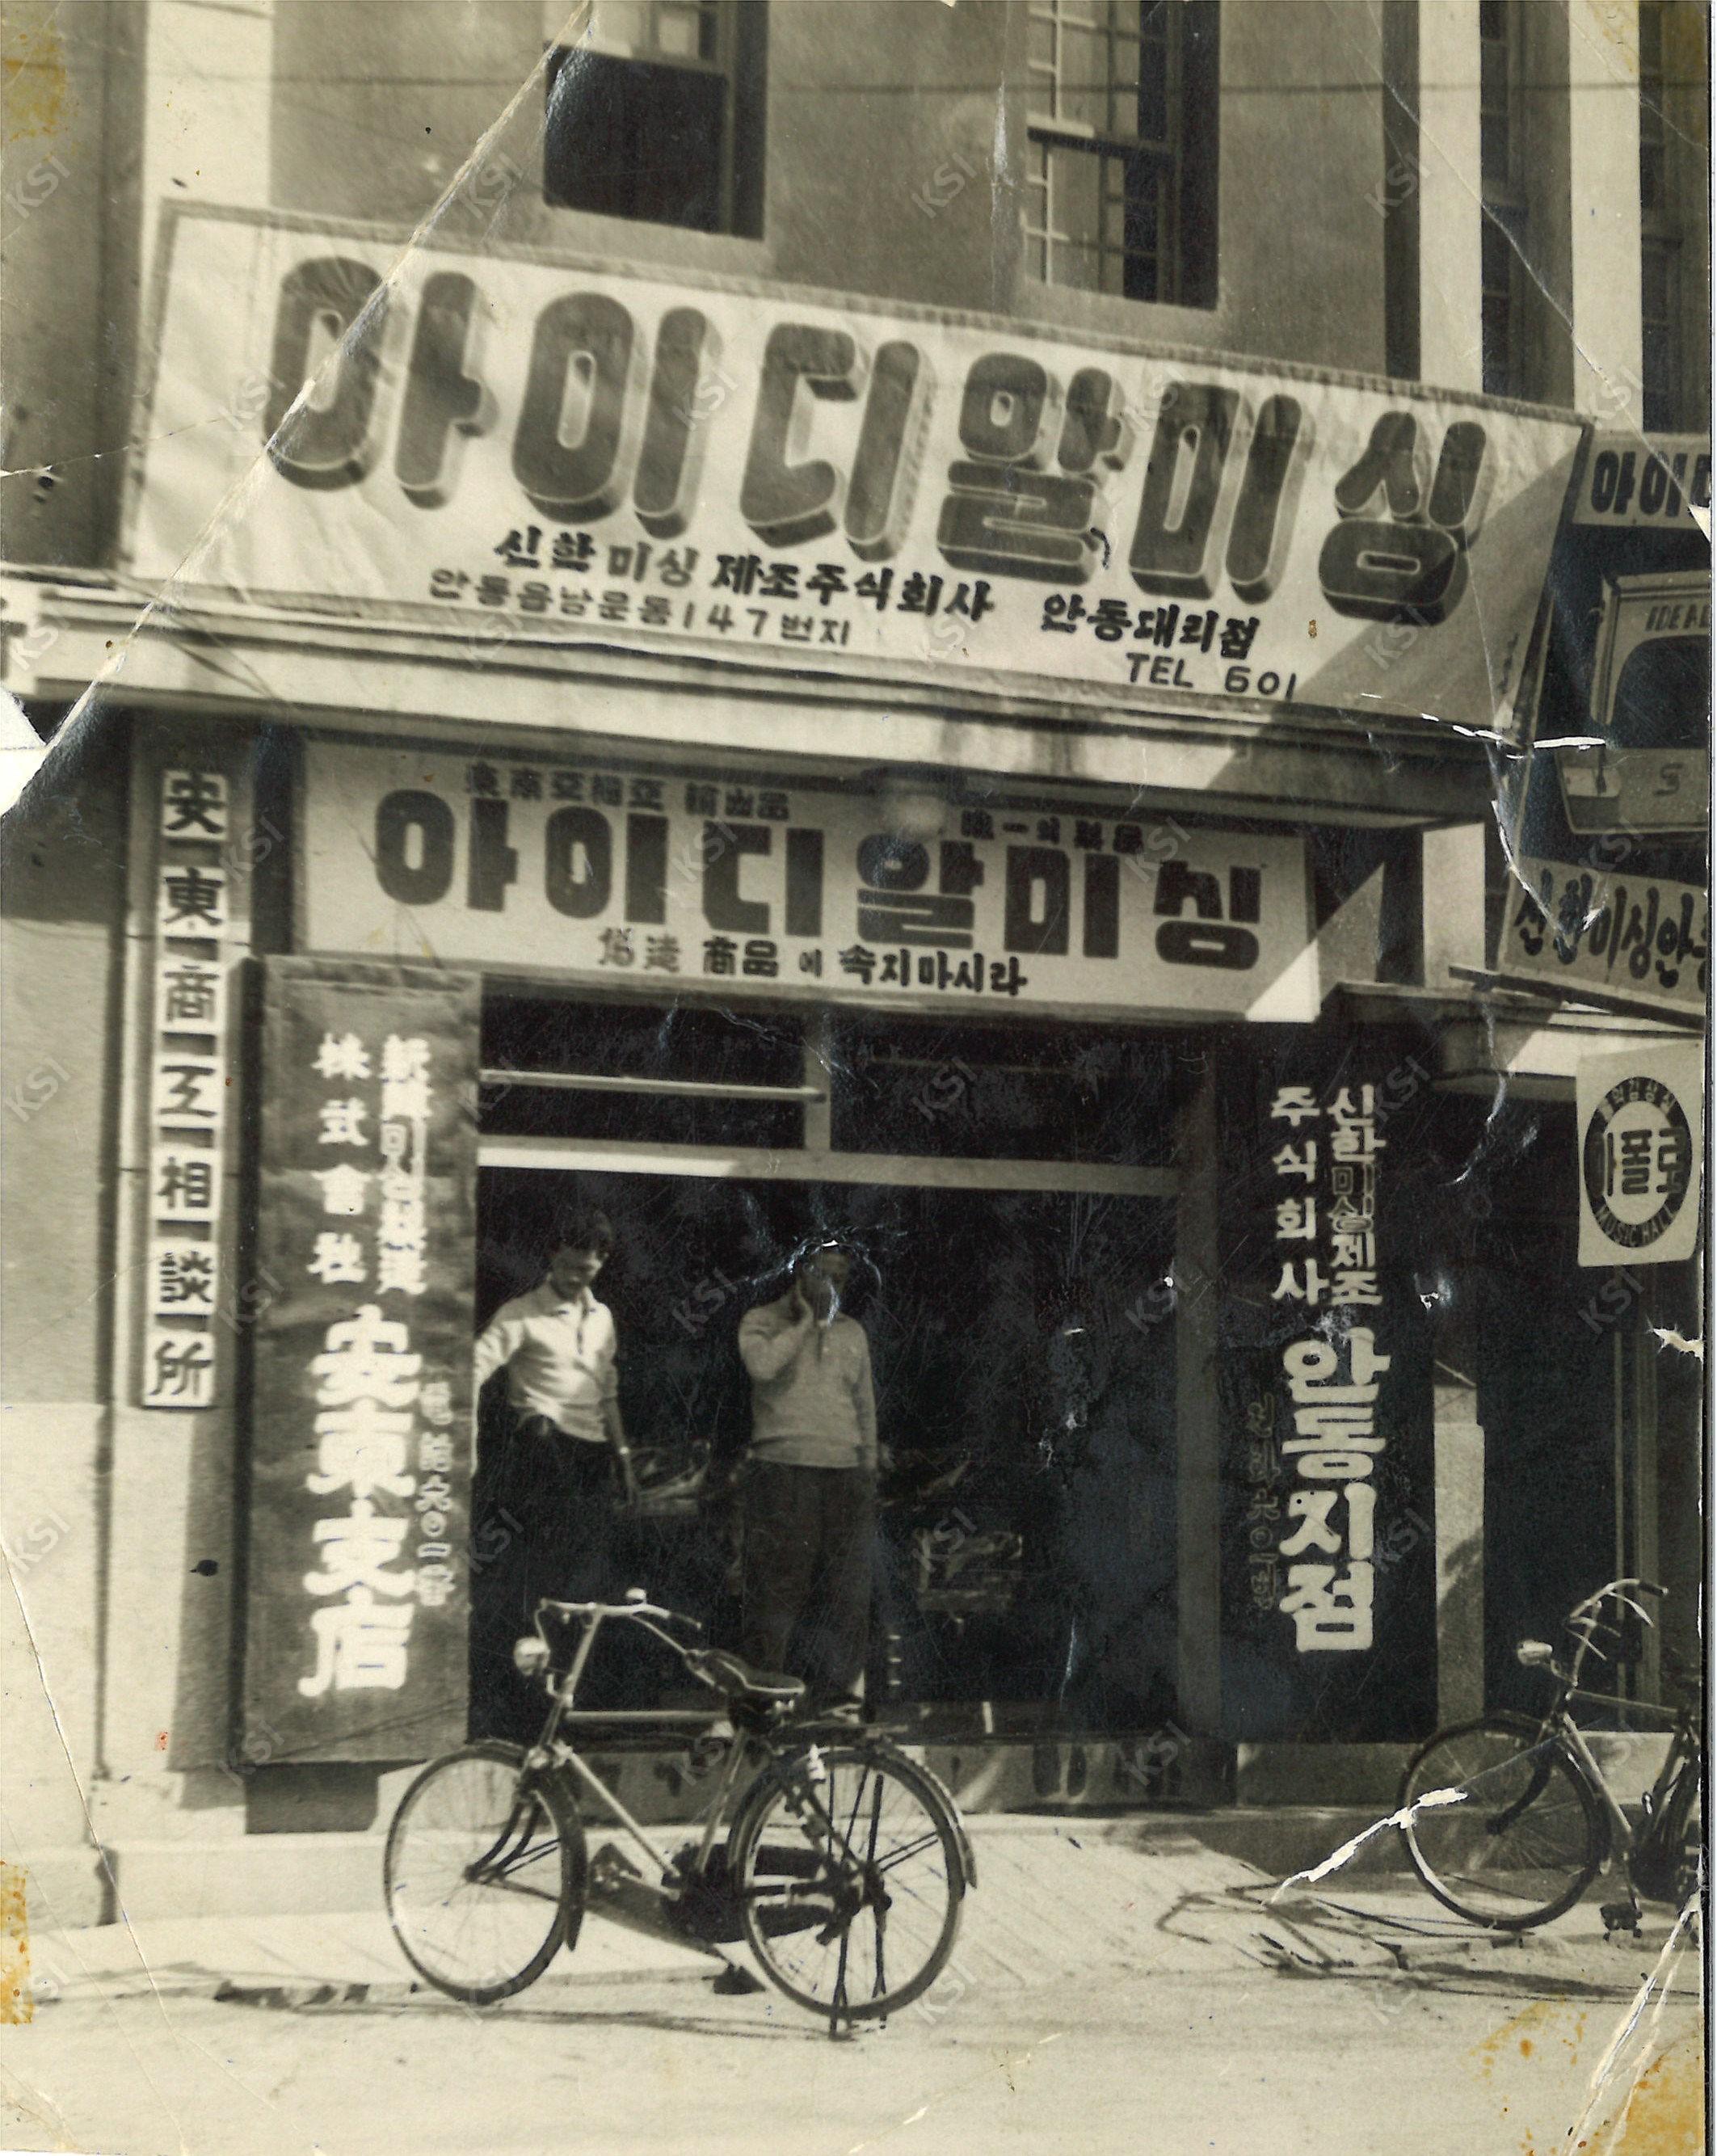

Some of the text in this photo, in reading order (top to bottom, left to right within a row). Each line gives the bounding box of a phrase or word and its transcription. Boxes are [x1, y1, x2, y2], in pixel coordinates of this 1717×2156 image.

[265, 256, 1490, 628] 아이디알미싱
[1041, 592, 1260, 660] 안동대리점
[1126, 651, 1297, 701] TEL 601
[374, 788, 1261, 971] 아이디알미싱
[838, 944, 1029, 996] 속지마시라
[1513, 868, 1710, 994] 신한미싱안
[1270, 1085, 1331, 1306] 주식회사
[297, 1303, 422, 1698] 安東支店
[1277, 1326, 1391, 1653] 안동지점
